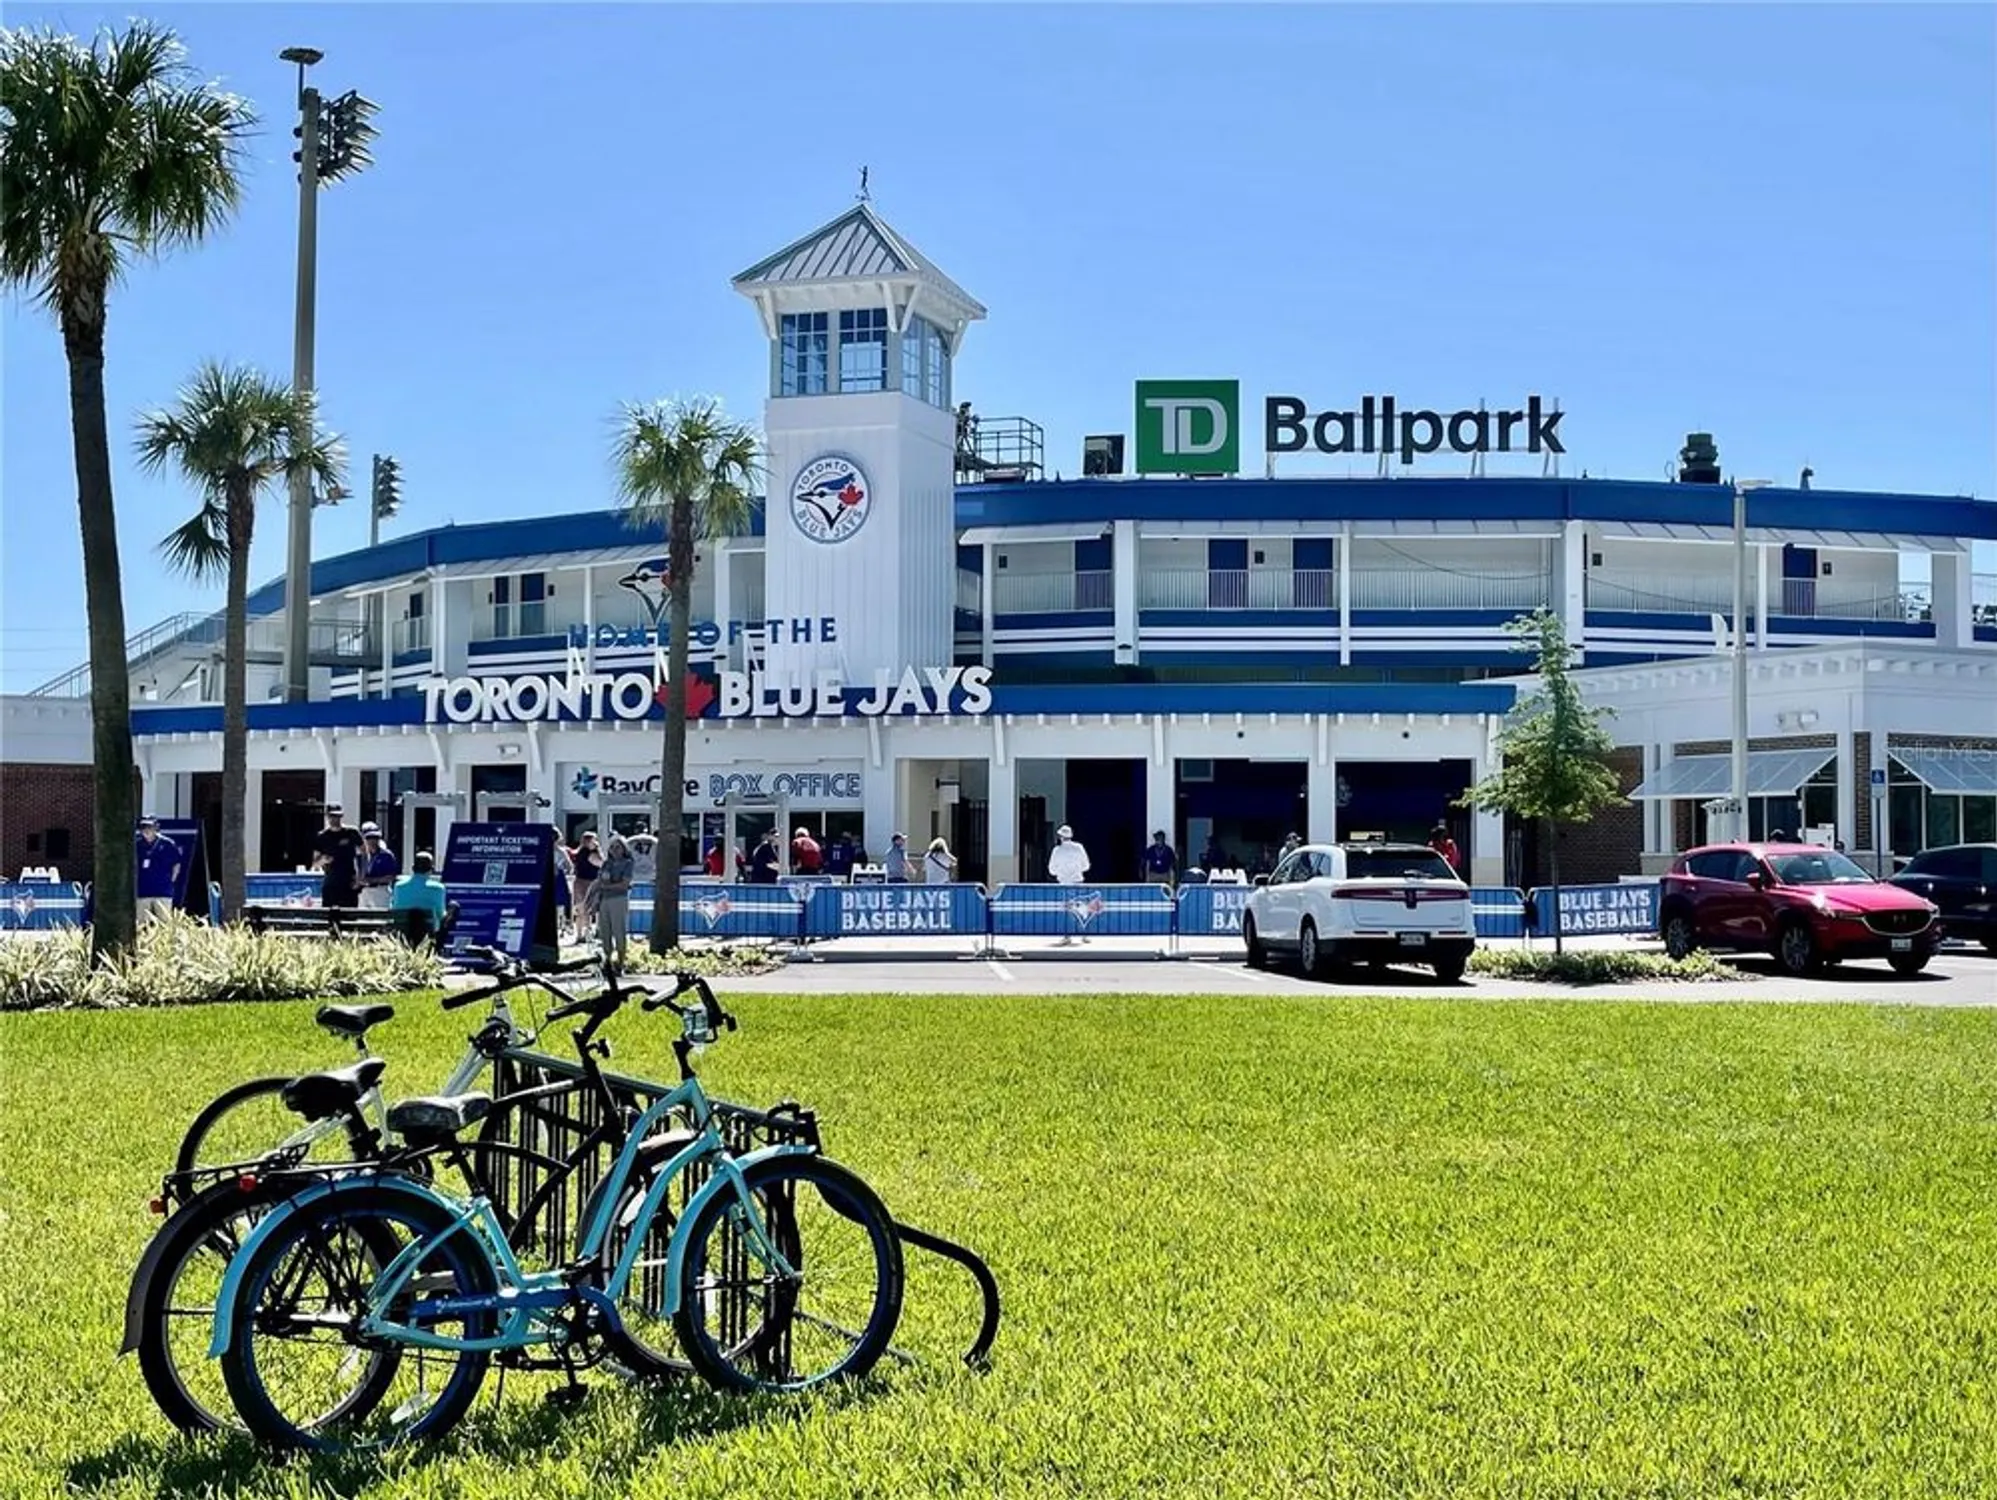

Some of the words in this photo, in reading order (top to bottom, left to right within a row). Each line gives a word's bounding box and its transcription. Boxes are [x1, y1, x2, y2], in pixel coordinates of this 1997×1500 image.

[1144, 397, 1229, 455] TD
[1266, 396, 1567, 464] Ballpark
[797, 462, 849, 491] TORONTO
[697, 621, 742, 647] OF
[768, 617, 837, 643] THE
[417, 672, 652, 723] TORONTO
[719, 667, 846, 717] BLUE
[856, 665, 993, 717] JAYS
[709, 773, 763, 798] BOX
[773, 772, 861, 798] OFFICE
[841, 891, 894, 909] BLUE
[900, 891, 951, 909] JAYS
[1559, 891, 1603, 911] BLUE
[1608, 889, 1652, 908] JAYS
[842, 911, 951, 930] BASEBALL
[1560, 908, 1653, 931] BASEBALL
